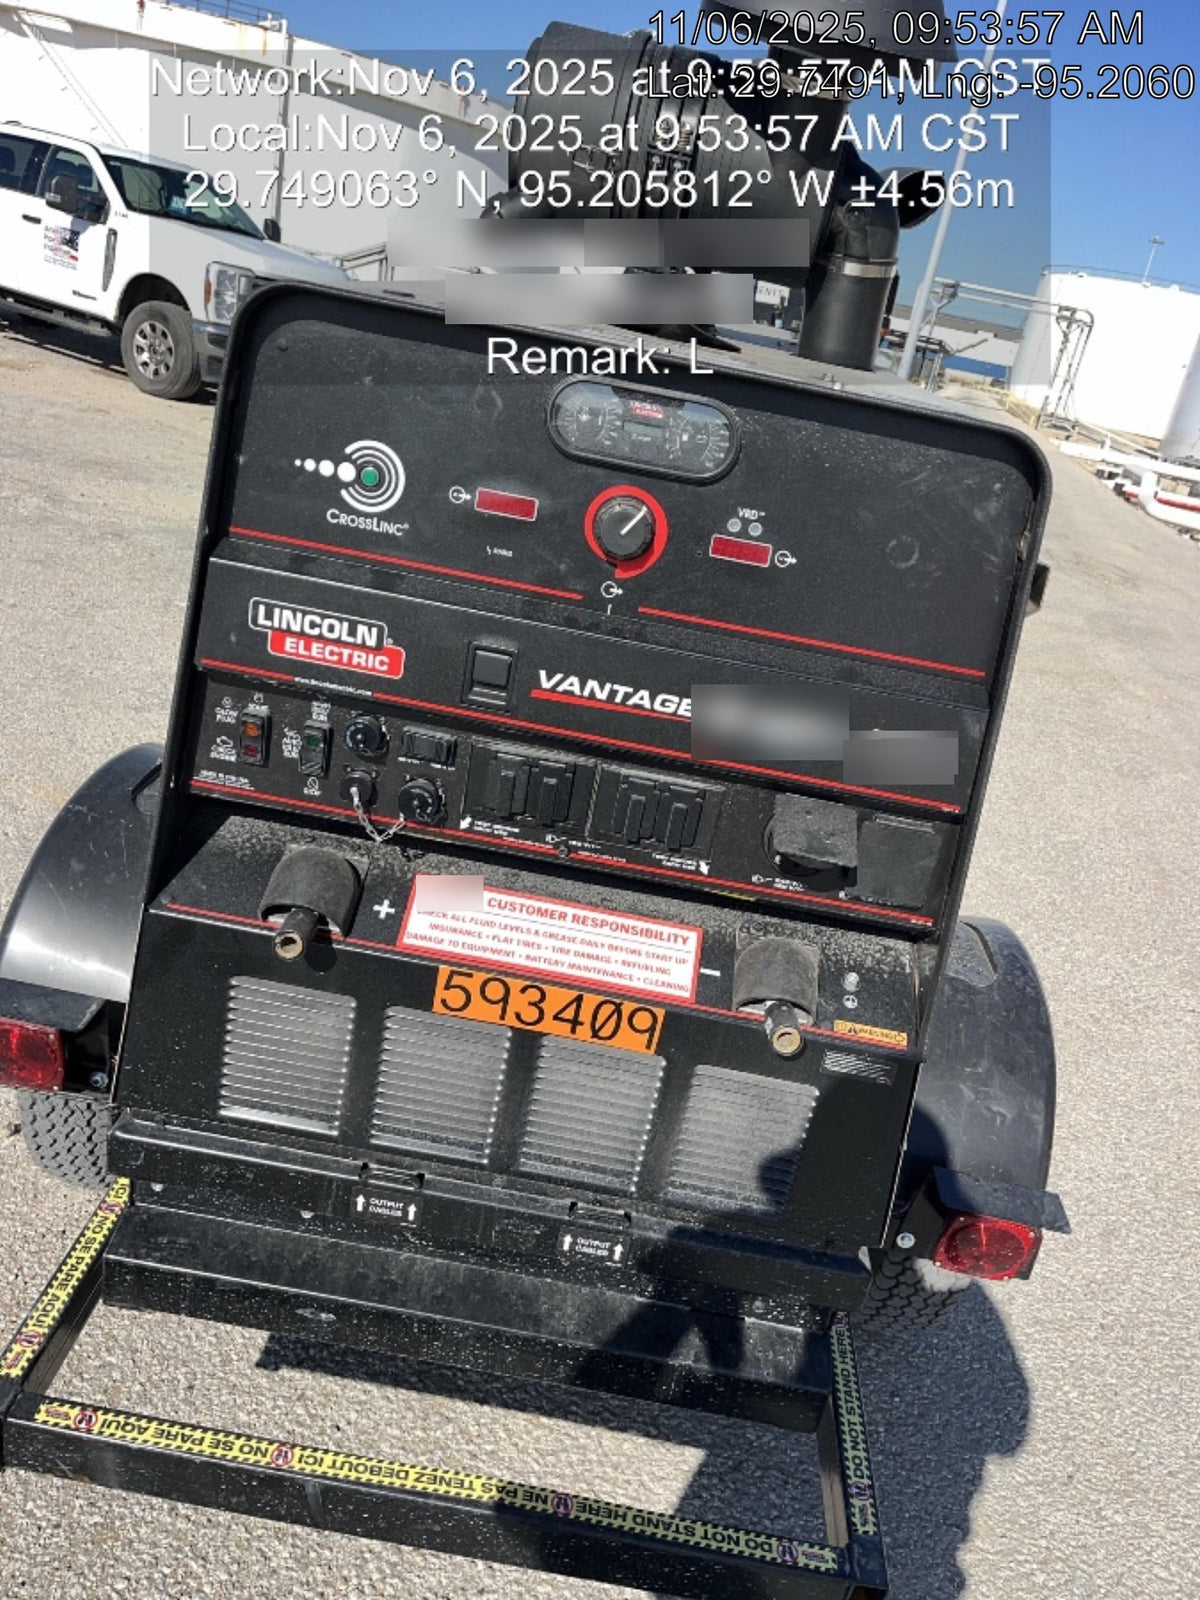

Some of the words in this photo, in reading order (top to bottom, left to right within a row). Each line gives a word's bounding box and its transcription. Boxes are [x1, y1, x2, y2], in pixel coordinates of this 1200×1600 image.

[256, 603, 378, 648] LINCOLN
[283, 636, 390, 671] ELECTRIC
[538, 669, 692, 717] VANTAGE
[487, 896, 568, 922] CUSTOMER
[571, 914, 690, 946] RESPONSIBILITY
[428, 922, 483, 939] INSURANCE
[516, 937, 543, 950] TIRES
[404, 931, 446, 945] DAMAGE
[461, 941, 516, 959] EQUIPMENT
[524, 950, 566, 968] BATTERY
[566, 961, 634, 982] MAINTENANCE
[439, 969, 660, 1050] 593409
[92, 1215, 110, 1235] NO
[79, 1236, 97, 1254] SE
[56, 1255, 86, 1292] PARE
[840, 1368, 856, 1416] STAND
[151, 1427, 207, 1449] PARE
[208, 1438, 235, 1453] SE
[847, 1419, 861, 1452] NOT
[238, 1442, 270, 1458] NO
[296, 1452, 325, 1468] ICI
[327, 1456, 410, 1481] DEBOUT
[413, 1470, 476, 1493] TENEZ
[481, 1481, 519, 1499] PAS
[522, 1490, 549, 1506] NE
[575, 1501, 629, 1523] HERE
[632, 1513, 697, 1538] STAND
[700, 1528, 742, 1547] NOT
[744, 1538, 774, 1554] DO
